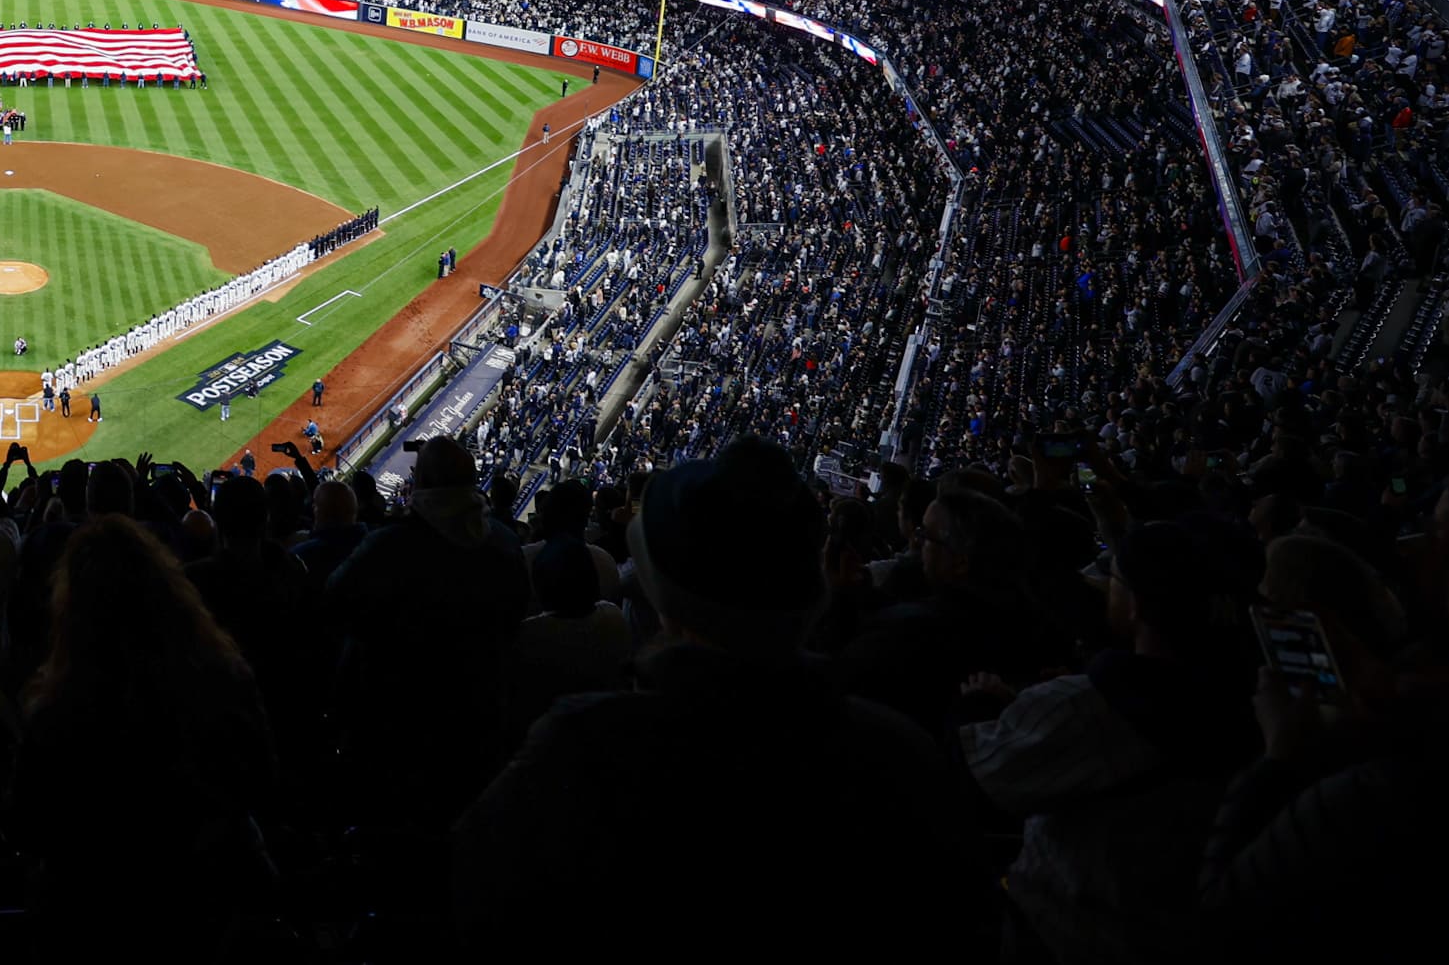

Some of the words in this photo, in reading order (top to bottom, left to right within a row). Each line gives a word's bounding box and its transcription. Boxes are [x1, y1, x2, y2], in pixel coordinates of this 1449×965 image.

[417, 17, 454, 29] MASON
[468, 28, 487, 36] BANK
[499, 33, 531, 44] AMERICA
[600, 47, 630, 63] WEBB
[186, 345, 293, 406] POSTSEASON
[429, 412, 454, 433] York
[443, 392, 474, 418] Yankees
